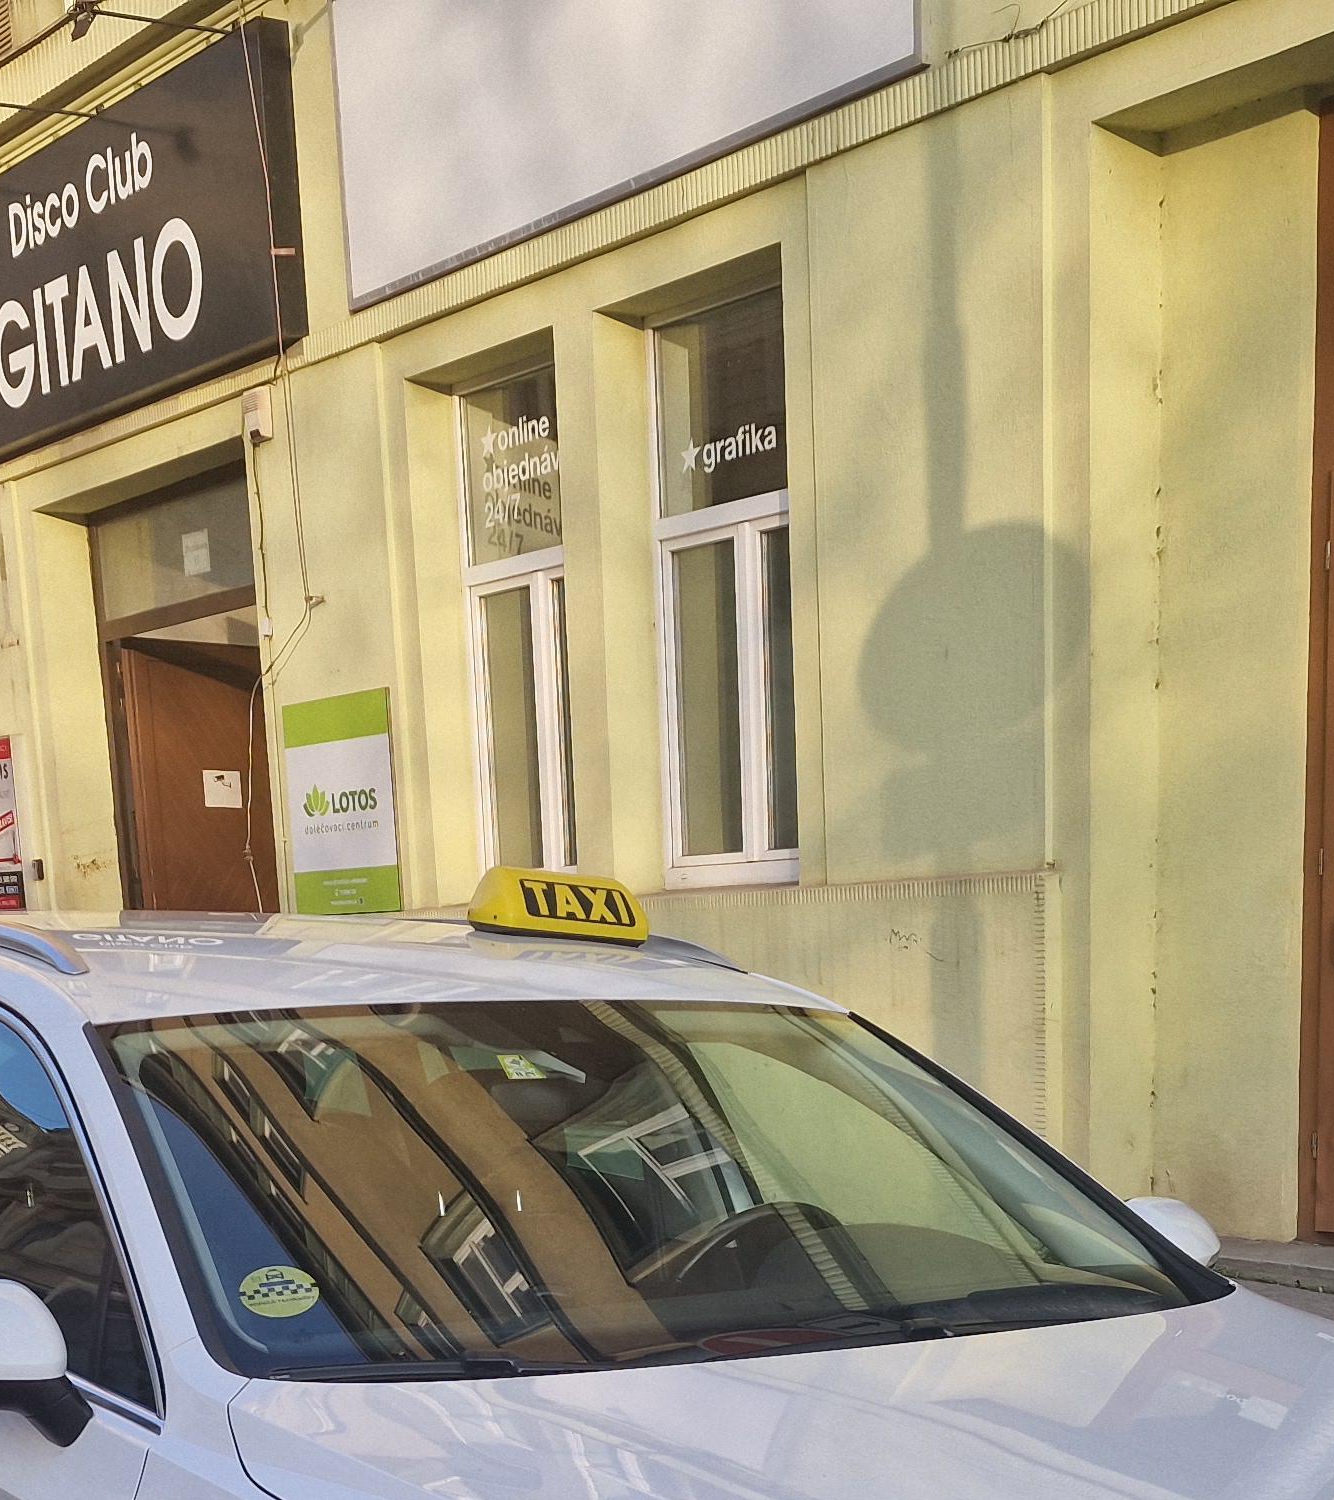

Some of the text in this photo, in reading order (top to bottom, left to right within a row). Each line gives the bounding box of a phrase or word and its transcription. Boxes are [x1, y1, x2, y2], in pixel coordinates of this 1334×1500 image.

[8, 132, 152, 259] Disco Club
[498, 415, 549, 451] online
[703, 422, 777, 473] grafika
[485, 493, 521, 529] 24/7
[331, 787, 378, 814] LOTOS
[523, 880, 631, 925] TAXI
